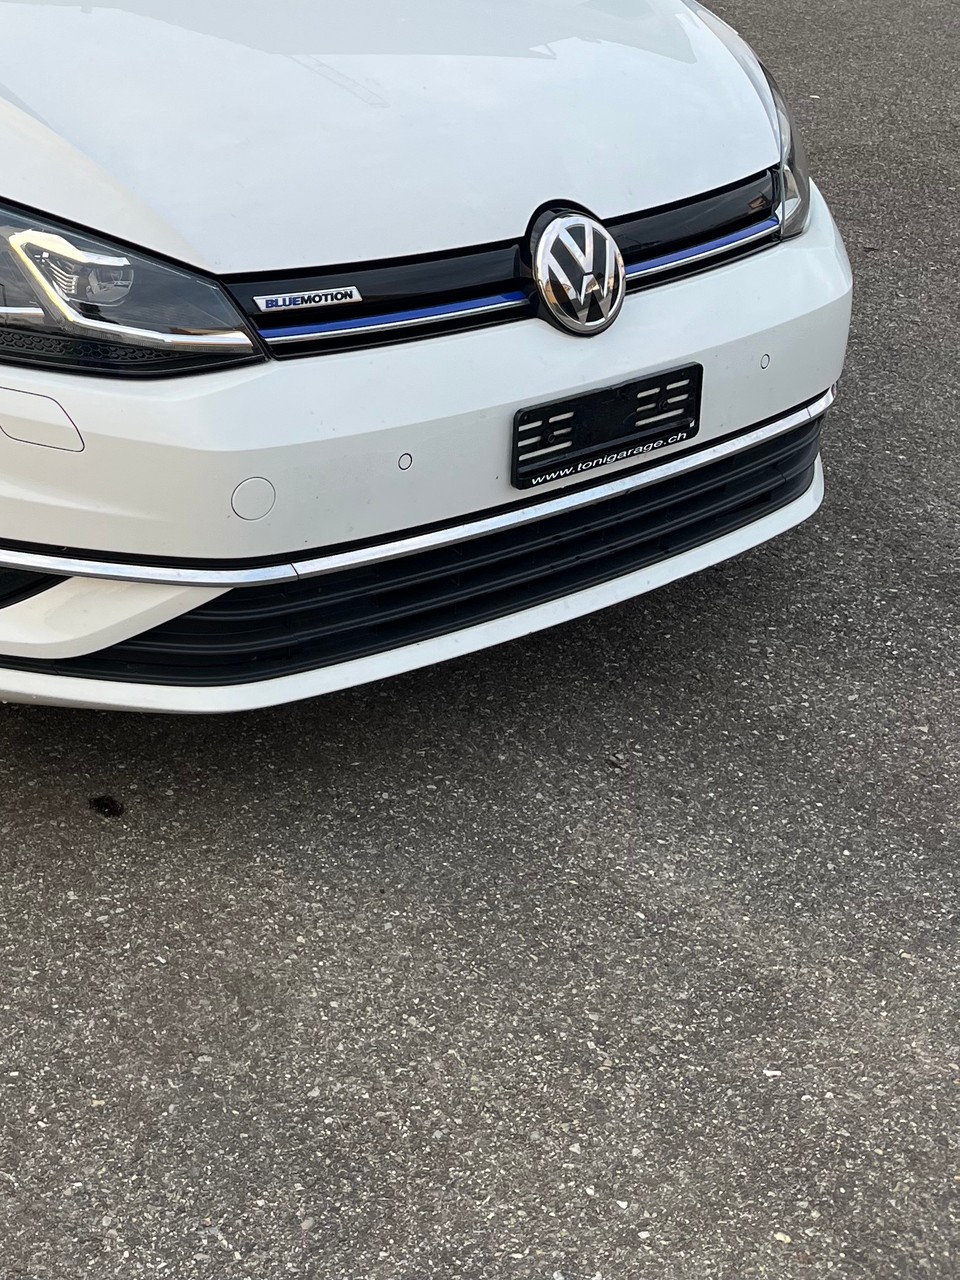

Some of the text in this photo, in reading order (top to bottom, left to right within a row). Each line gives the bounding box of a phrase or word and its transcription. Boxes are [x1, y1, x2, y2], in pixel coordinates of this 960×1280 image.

[539, 217, 622, 327] VW
[265, 290, 354, 309] BLUEMOTION
[531, 431, 688, 485] www.tonigarage.ch
